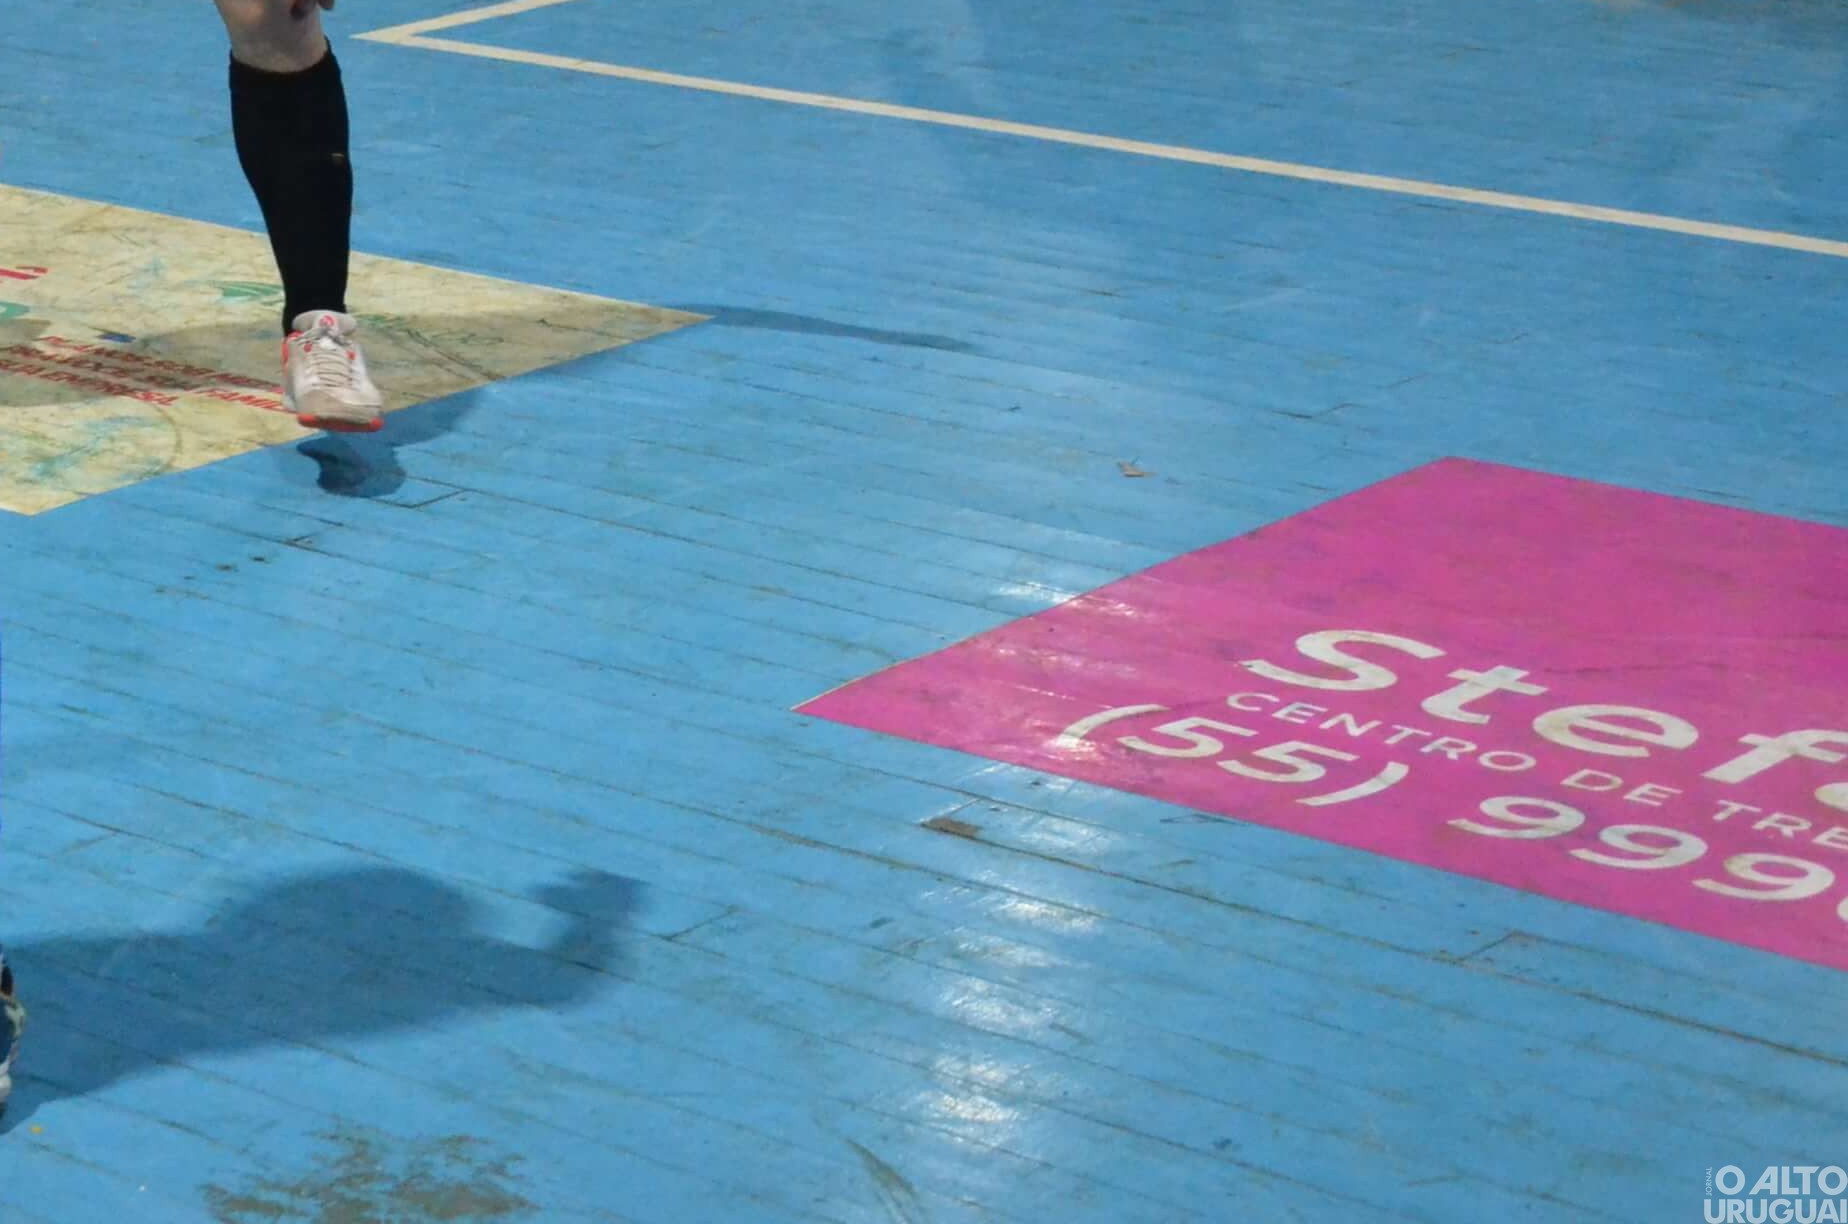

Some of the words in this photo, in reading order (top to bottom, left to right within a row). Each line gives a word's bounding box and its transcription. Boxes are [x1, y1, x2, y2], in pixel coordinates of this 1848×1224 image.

[1056, 703, 1409, 806] (55)
[1447, 796, 1848, 923] 999
[1225, 692, 1537, 771] CENTRO
[1560, 769, 1684, 807] DE
[1240, 629, 1848, 814] Stef
